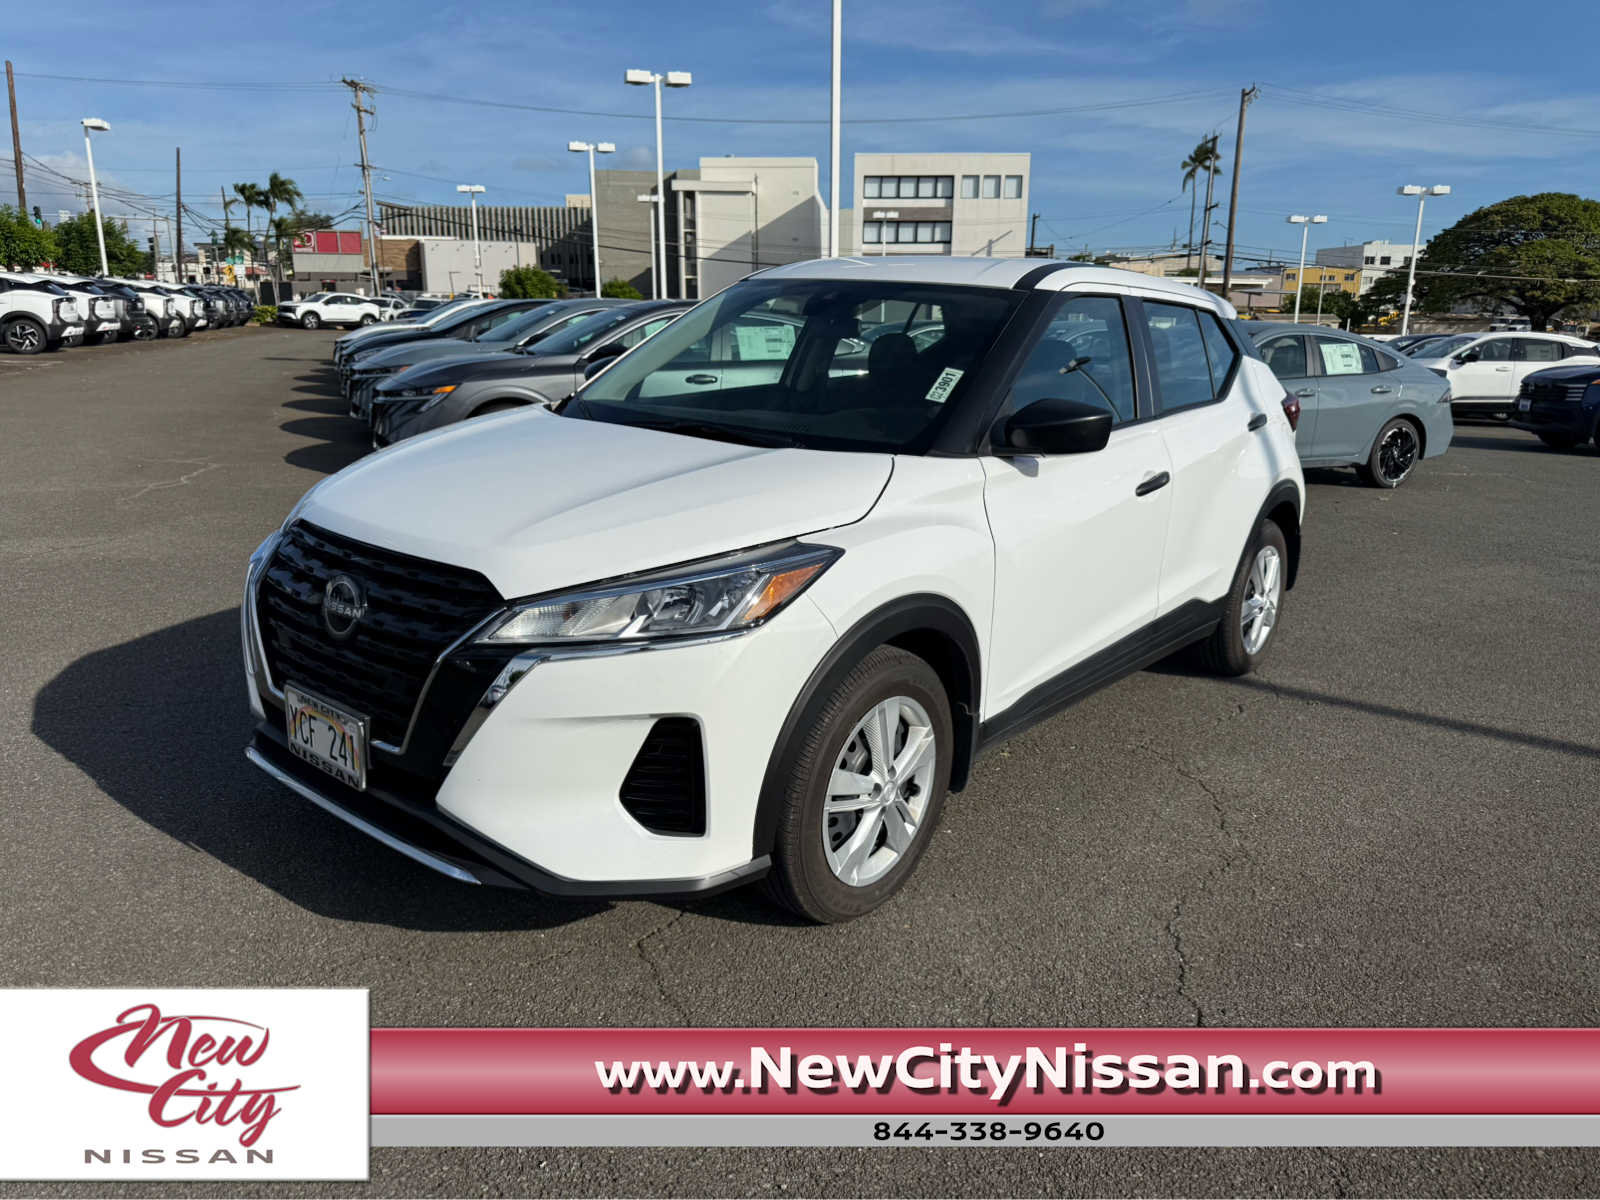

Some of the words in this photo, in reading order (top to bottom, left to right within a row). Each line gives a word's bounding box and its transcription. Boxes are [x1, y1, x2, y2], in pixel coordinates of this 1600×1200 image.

[289, 742, 360, 789] NISSAN
[290, 703, 317, 748] YCF
[327, 724, 356, 771] 241
